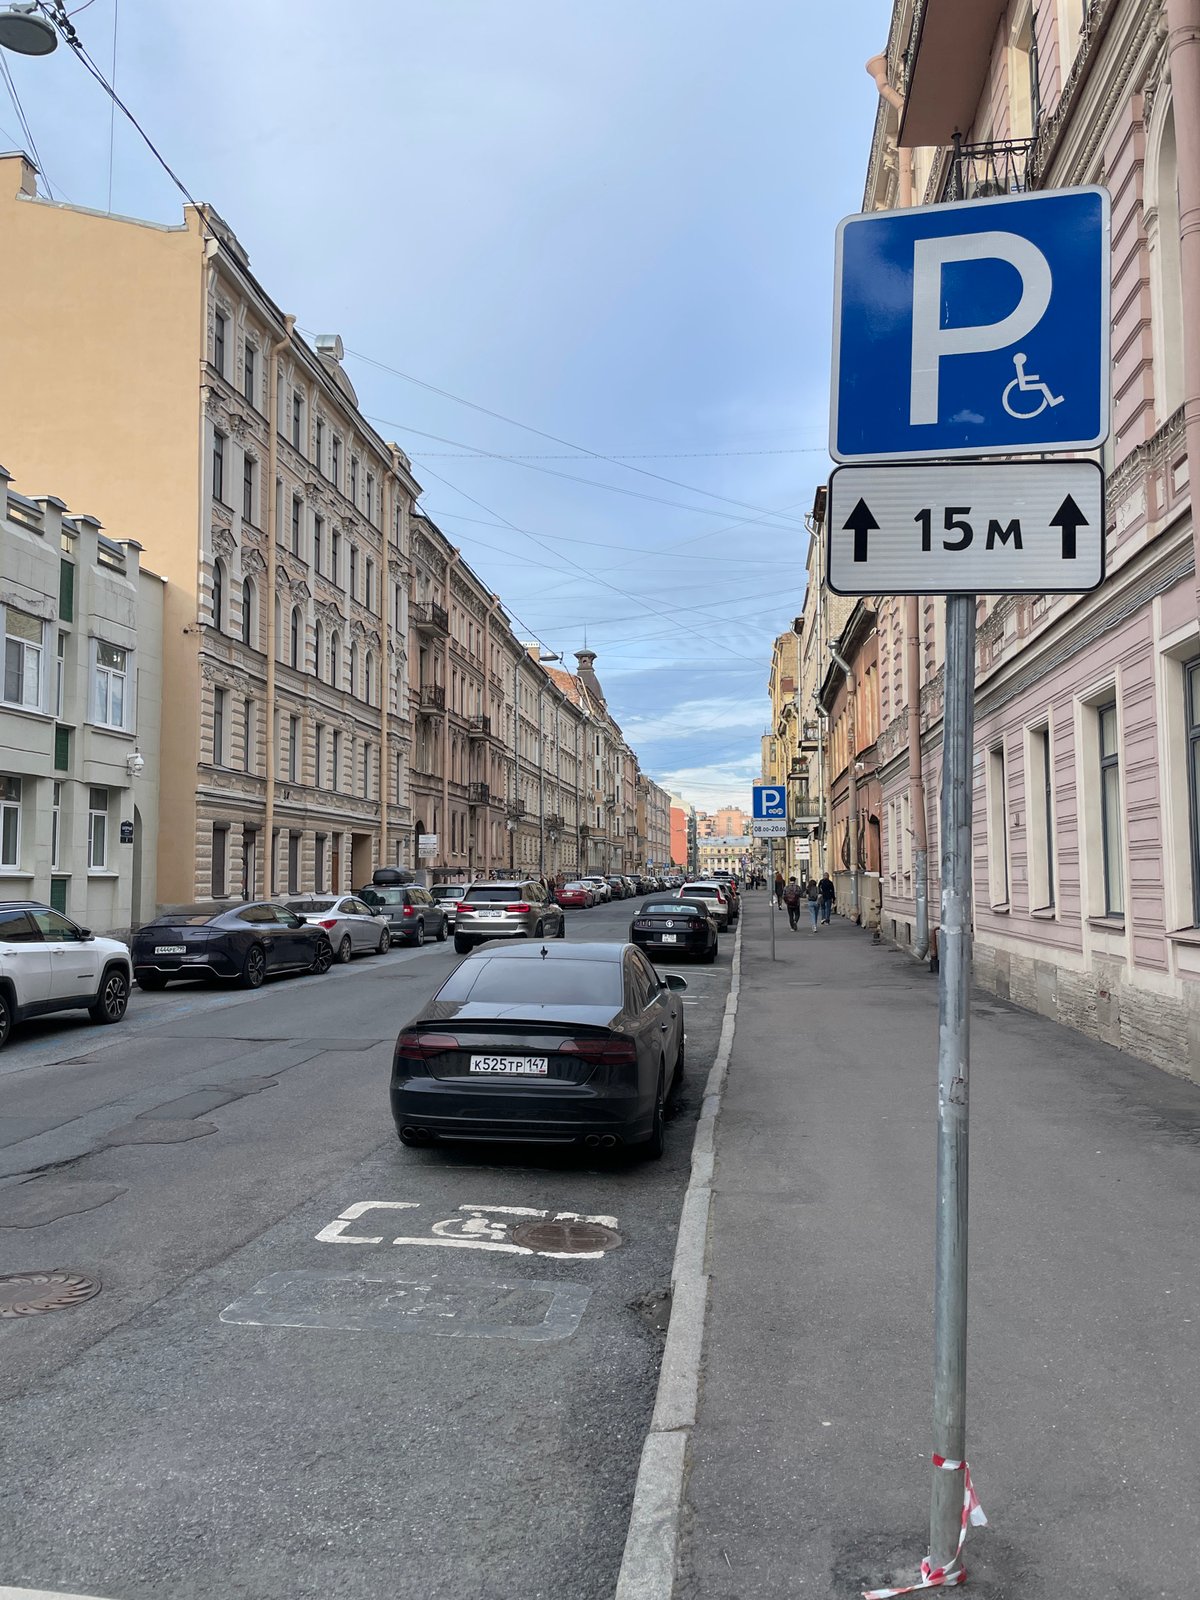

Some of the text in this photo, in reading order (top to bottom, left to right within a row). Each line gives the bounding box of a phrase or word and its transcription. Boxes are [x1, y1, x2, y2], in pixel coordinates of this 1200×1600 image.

[909, 231, 1053, 426] P
[913, 506, 974, 552] 15
[761, 789, 780, 815] P
[526, 1058, 545, 1069] 147
